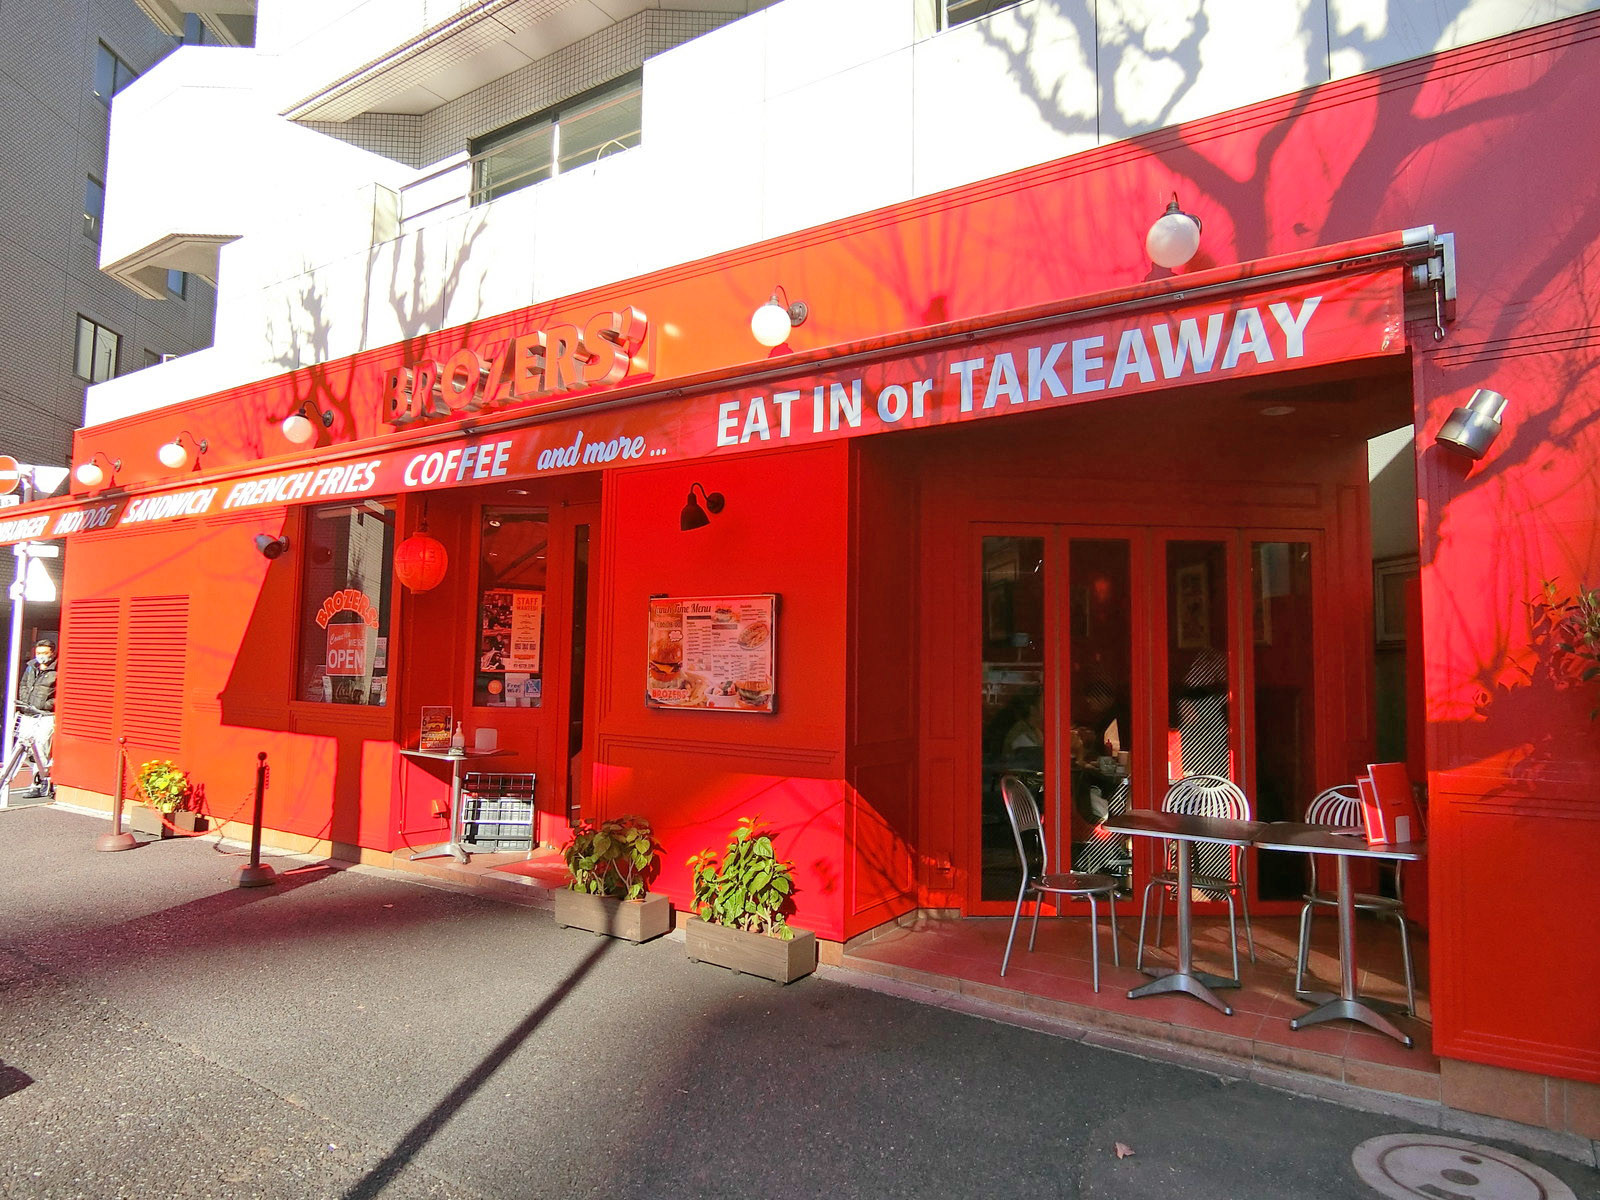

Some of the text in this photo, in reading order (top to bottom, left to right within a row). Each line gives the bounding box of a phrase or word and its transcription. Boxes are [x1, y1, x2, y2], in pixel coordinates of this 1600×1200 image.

[382, 305, 648, 425] BROZERS'
[716, 296, 1323, 448] EAT IN or TAKEAWAY
[121, 487, 219, 524] SANDWICH
[223, 471, 315, 510] FRENCH
[310, 459, 382, 498] FRIES
[403, 440, 513, 487] COFFEE
[537, 430, 585, 470] and
[583, 435, 647, 466] more
[516, 597, 538, 606] STAFF
[690, 603, 712, 613] Menu
[328, 649, 364, 669] OPEN
